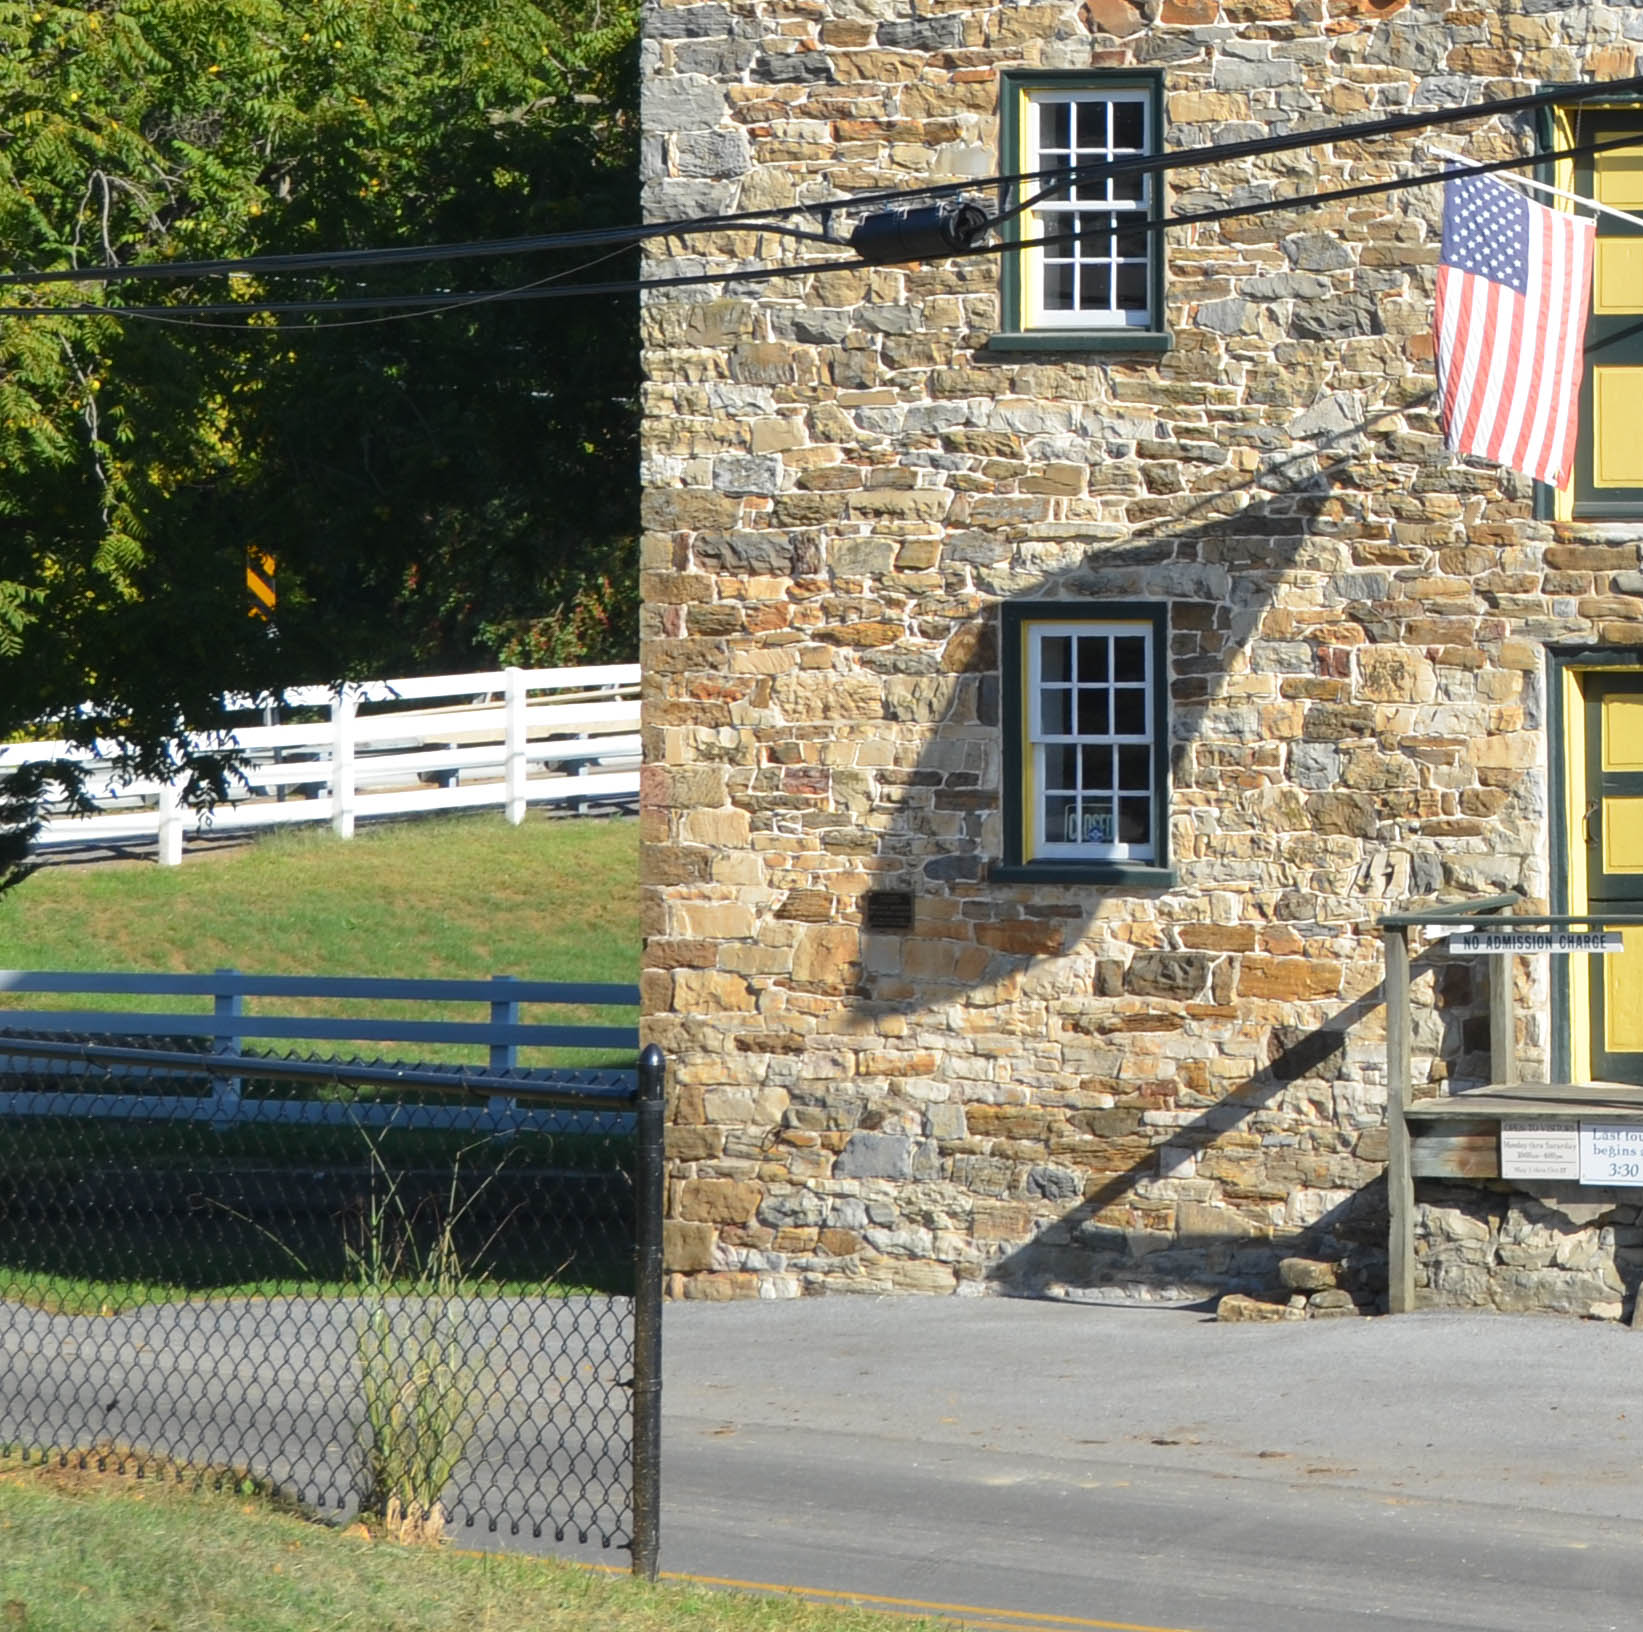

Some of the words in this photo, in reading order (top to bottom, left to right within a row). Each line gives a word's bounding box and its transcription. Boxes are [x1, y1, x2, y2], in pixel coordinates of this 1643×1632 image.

[1463, 935, 1480, 950] NO
[1486, 935, 1552, 950] ADMISSION
[1558, 934, 1607, 949] CHARGE
[1592, 1128, 1621, 1141] Last
[1593, 1144, 1637, 1158] begins
[1608, 1163, 1639, 1177] 3:30
